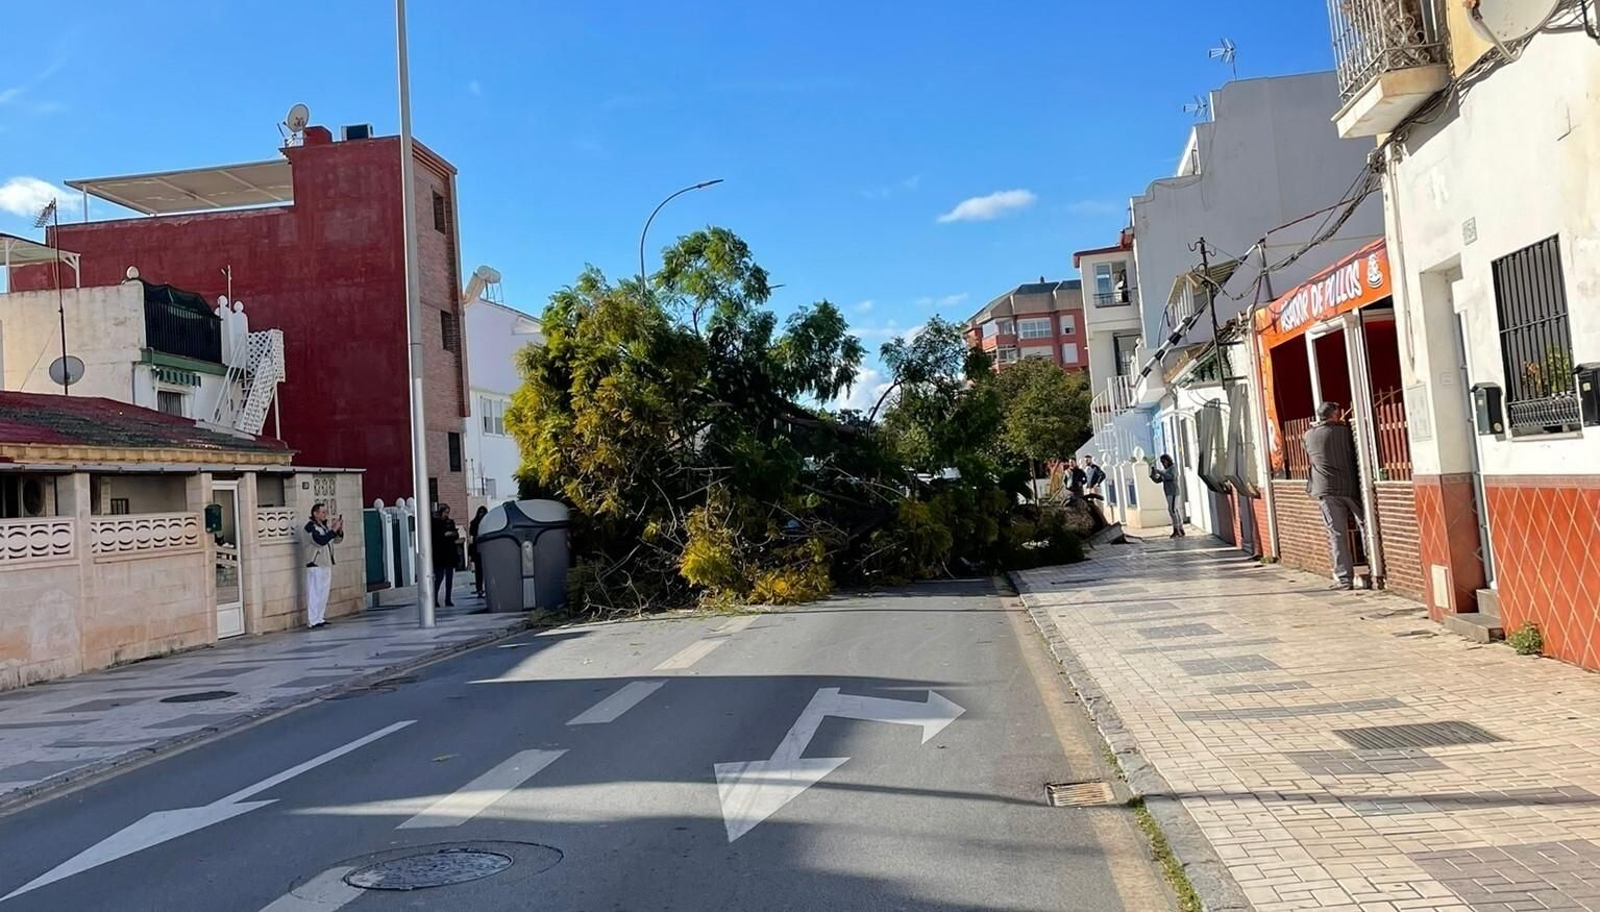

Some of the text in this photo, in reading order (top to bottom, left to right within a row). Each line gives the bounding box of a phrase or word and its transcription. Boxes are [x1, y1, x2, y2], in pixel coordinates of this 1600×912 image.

[1280, 260, 1363, 333] ASADOR DE POLLOS
